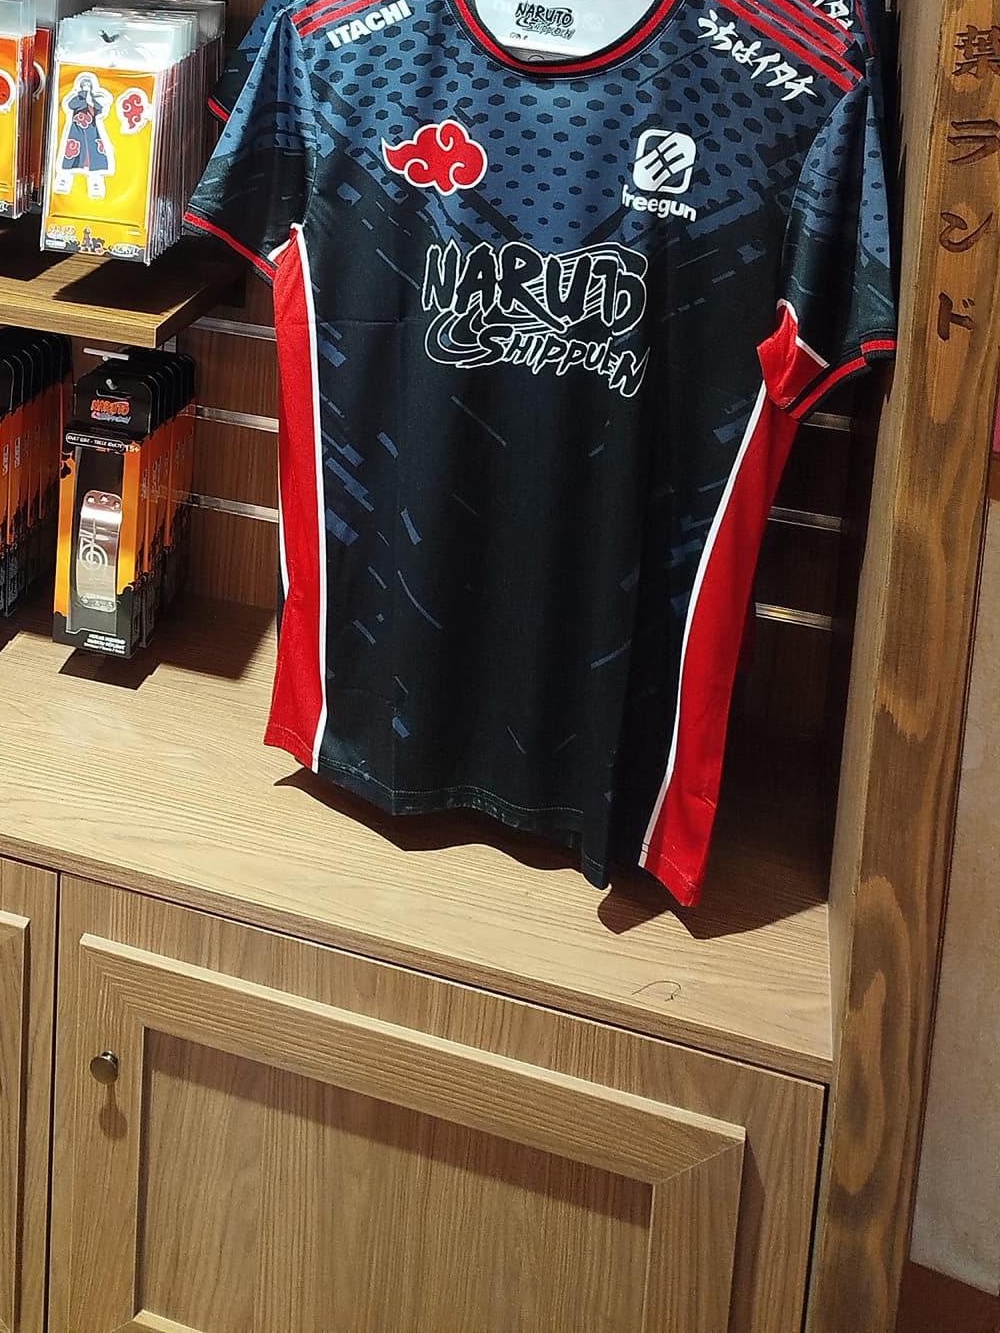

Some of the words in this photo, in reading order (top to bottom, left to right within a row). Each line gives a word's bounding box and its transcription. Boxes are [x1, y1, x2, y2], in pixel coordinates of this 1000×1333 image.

[325, 0, 413, 49] ITACHI
[515, 1, 575, 28] NARUTO
[697, 9, 818, 102] うちはイタチ
[622, 185, 697, 222] freegun
[422, 239, 649, 336] NARUTO
